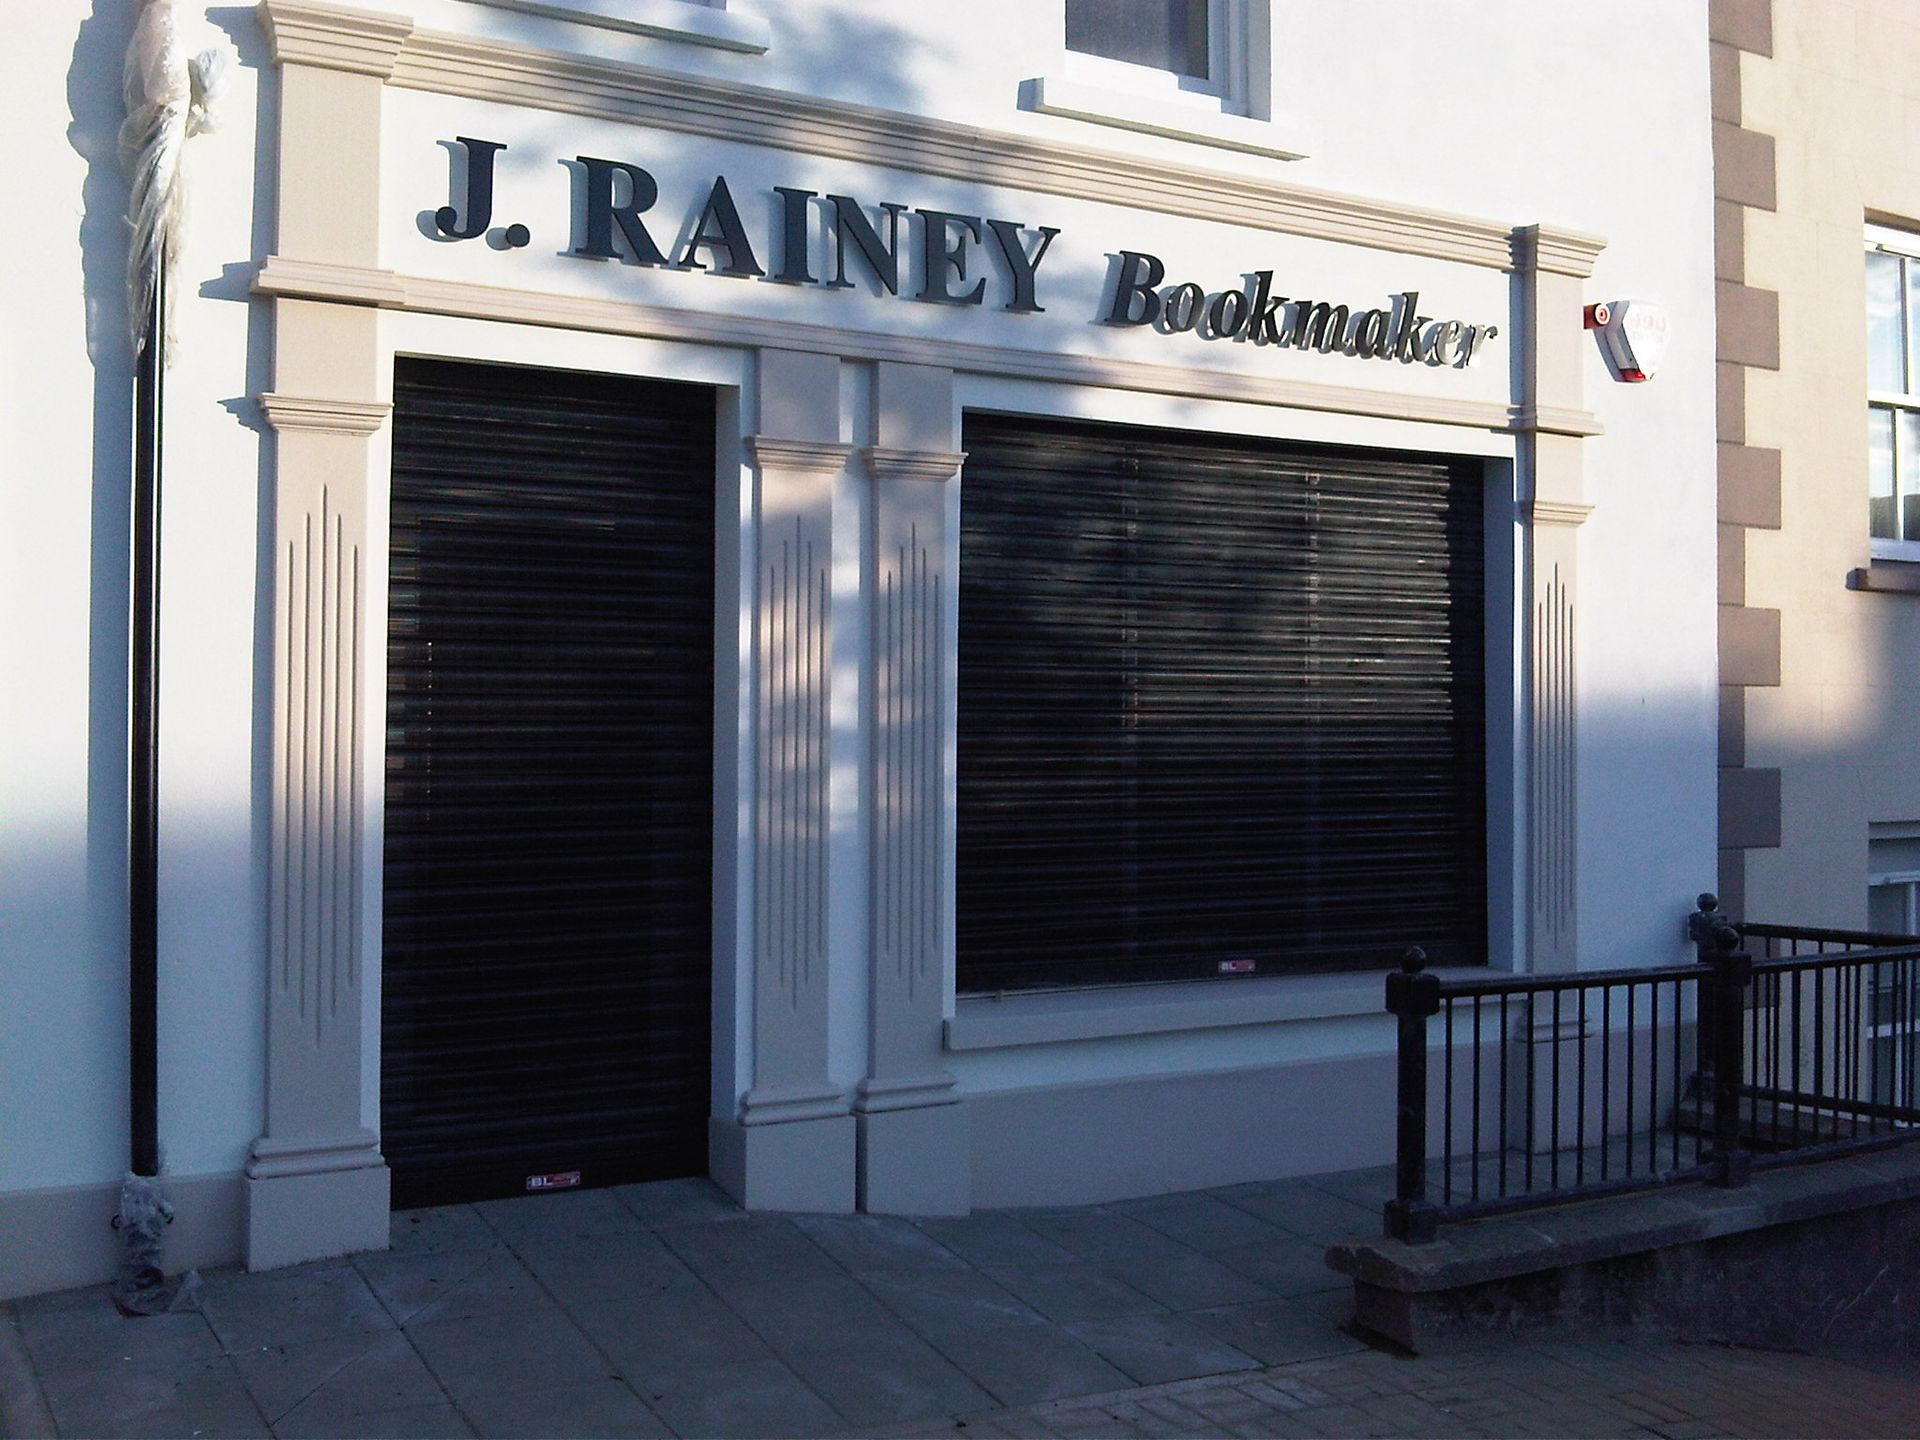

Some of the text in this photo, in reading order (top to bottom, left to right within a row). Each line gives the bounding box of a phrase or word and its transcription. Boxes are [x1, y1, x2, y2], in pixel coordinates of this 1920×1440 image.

[435, 136, 1498, 369] J. RAINEY Bookmaker
